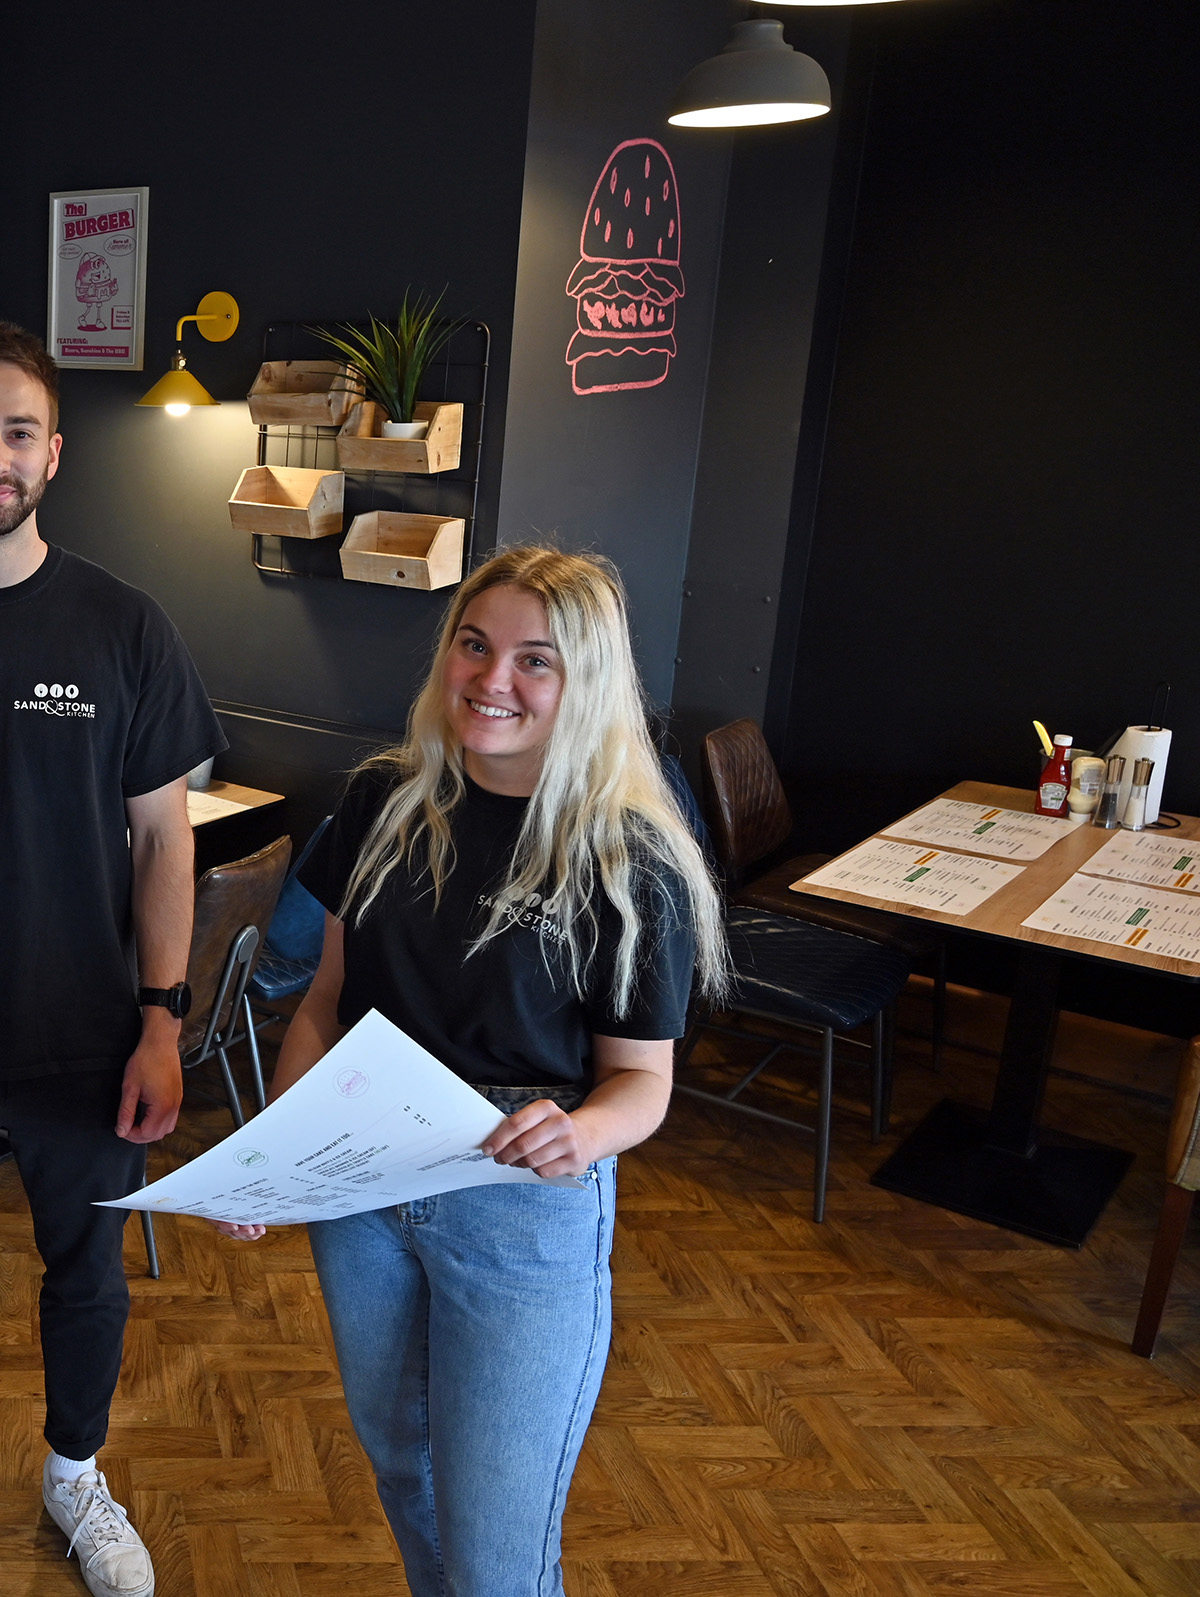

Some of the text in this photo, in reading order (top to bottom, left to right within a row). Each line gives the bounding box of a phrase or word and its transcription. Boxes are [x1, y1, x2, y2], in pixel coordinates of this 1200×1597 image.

[65, 203, 84, 215] The
[64, 211, 131, 239] BURGER
[66, 711, 95, 719] KITCHEN
